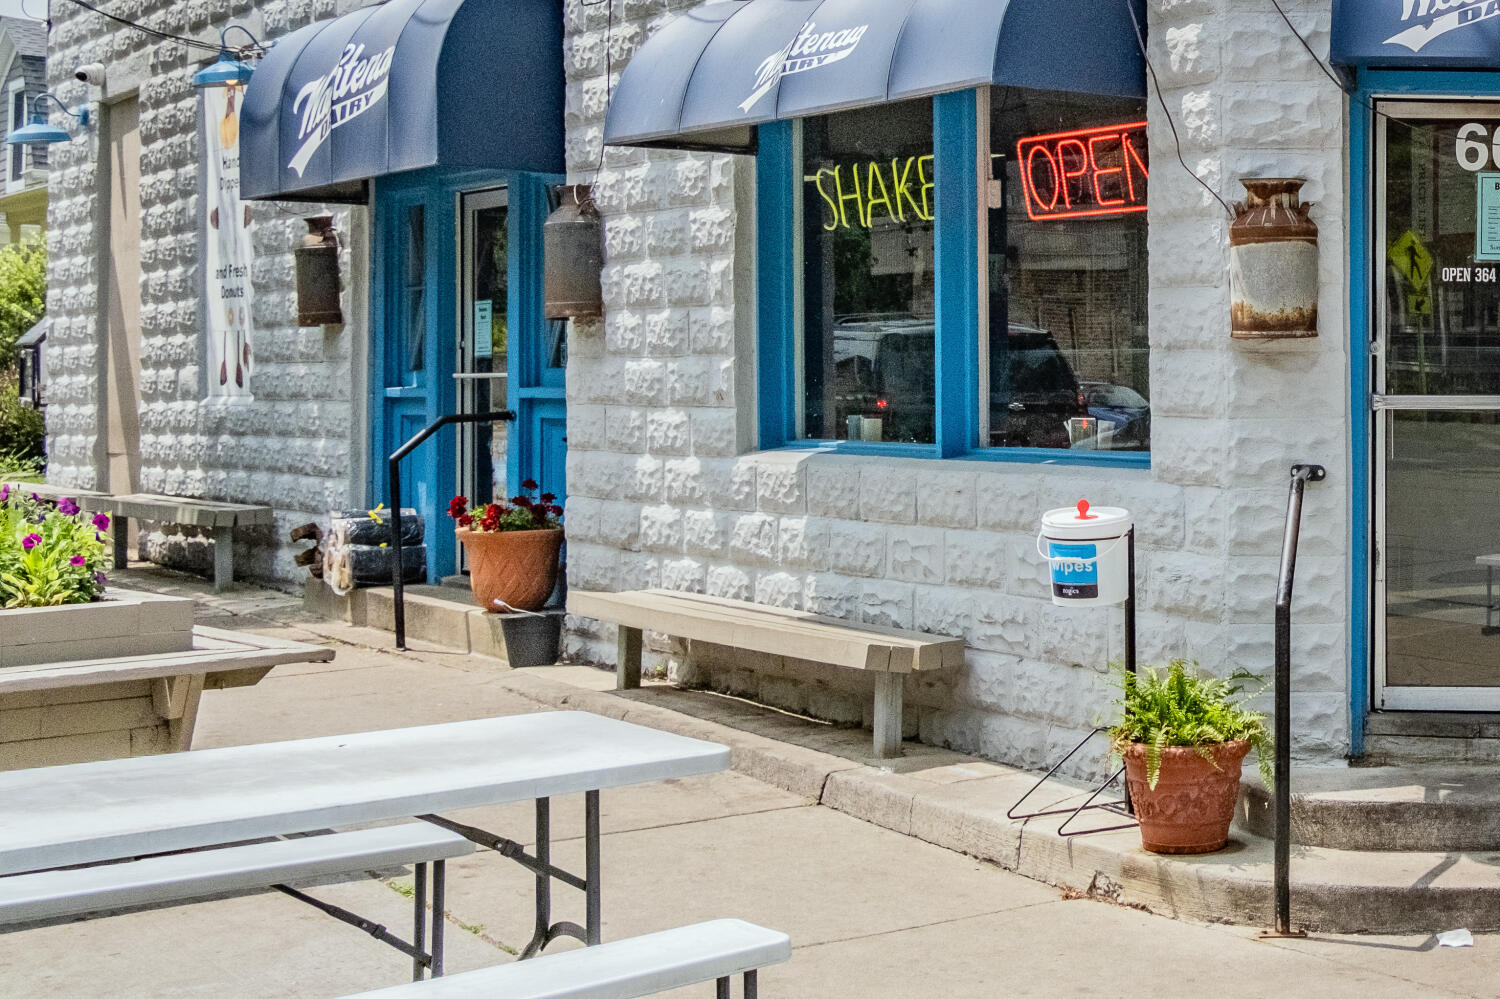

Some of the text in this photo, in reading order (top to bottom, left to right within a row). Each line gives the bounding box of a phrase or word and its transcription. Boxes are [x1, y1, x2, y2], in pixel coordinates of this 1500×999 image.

[1027, 133, 1149, 210] OPEN
[1442, 267, 1472, 283] OPEN
[1474, 267, 1497, 283] 364
[220, 286, 245, 299] Donuts
